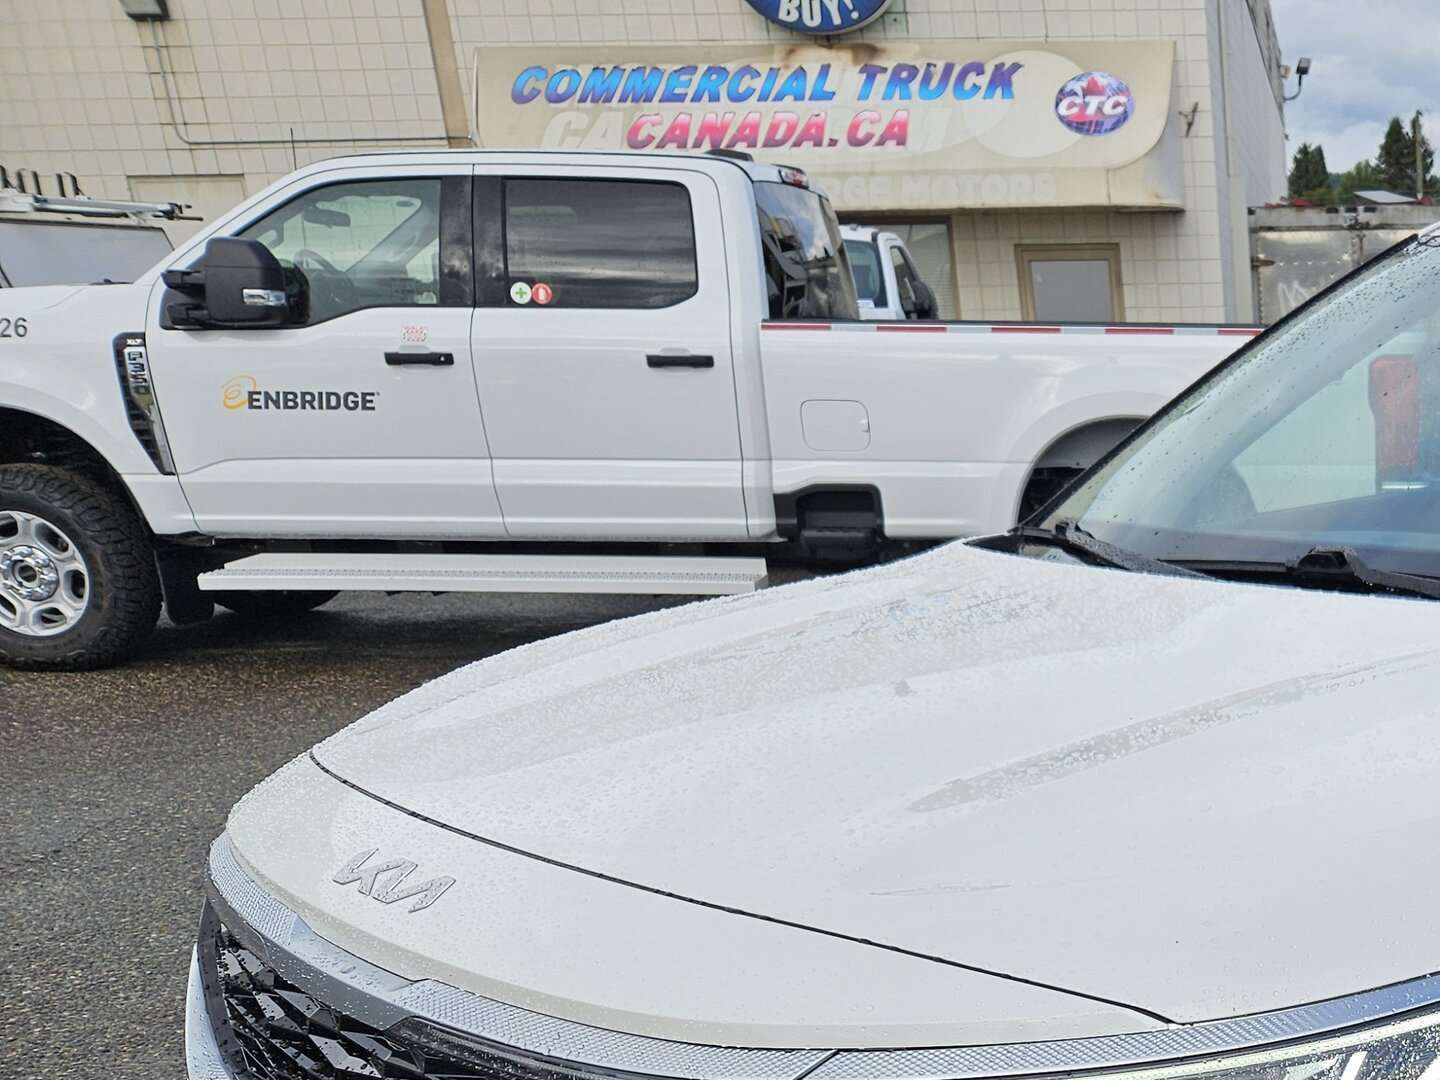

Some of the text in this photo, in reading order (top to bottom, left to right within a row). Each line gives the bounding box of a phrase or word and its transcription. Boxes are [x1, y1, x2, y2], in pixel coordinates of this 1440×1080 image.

[778, 0, 859, 27] BUY!
[511, 61, 1025, 105] COMMERCIAL TRUCK
[1058, 94, 1129, 116] CTC
[626, 109, 911, 150] CANADA.CA
[247, 391, 376, 411] ENBRIDGE
